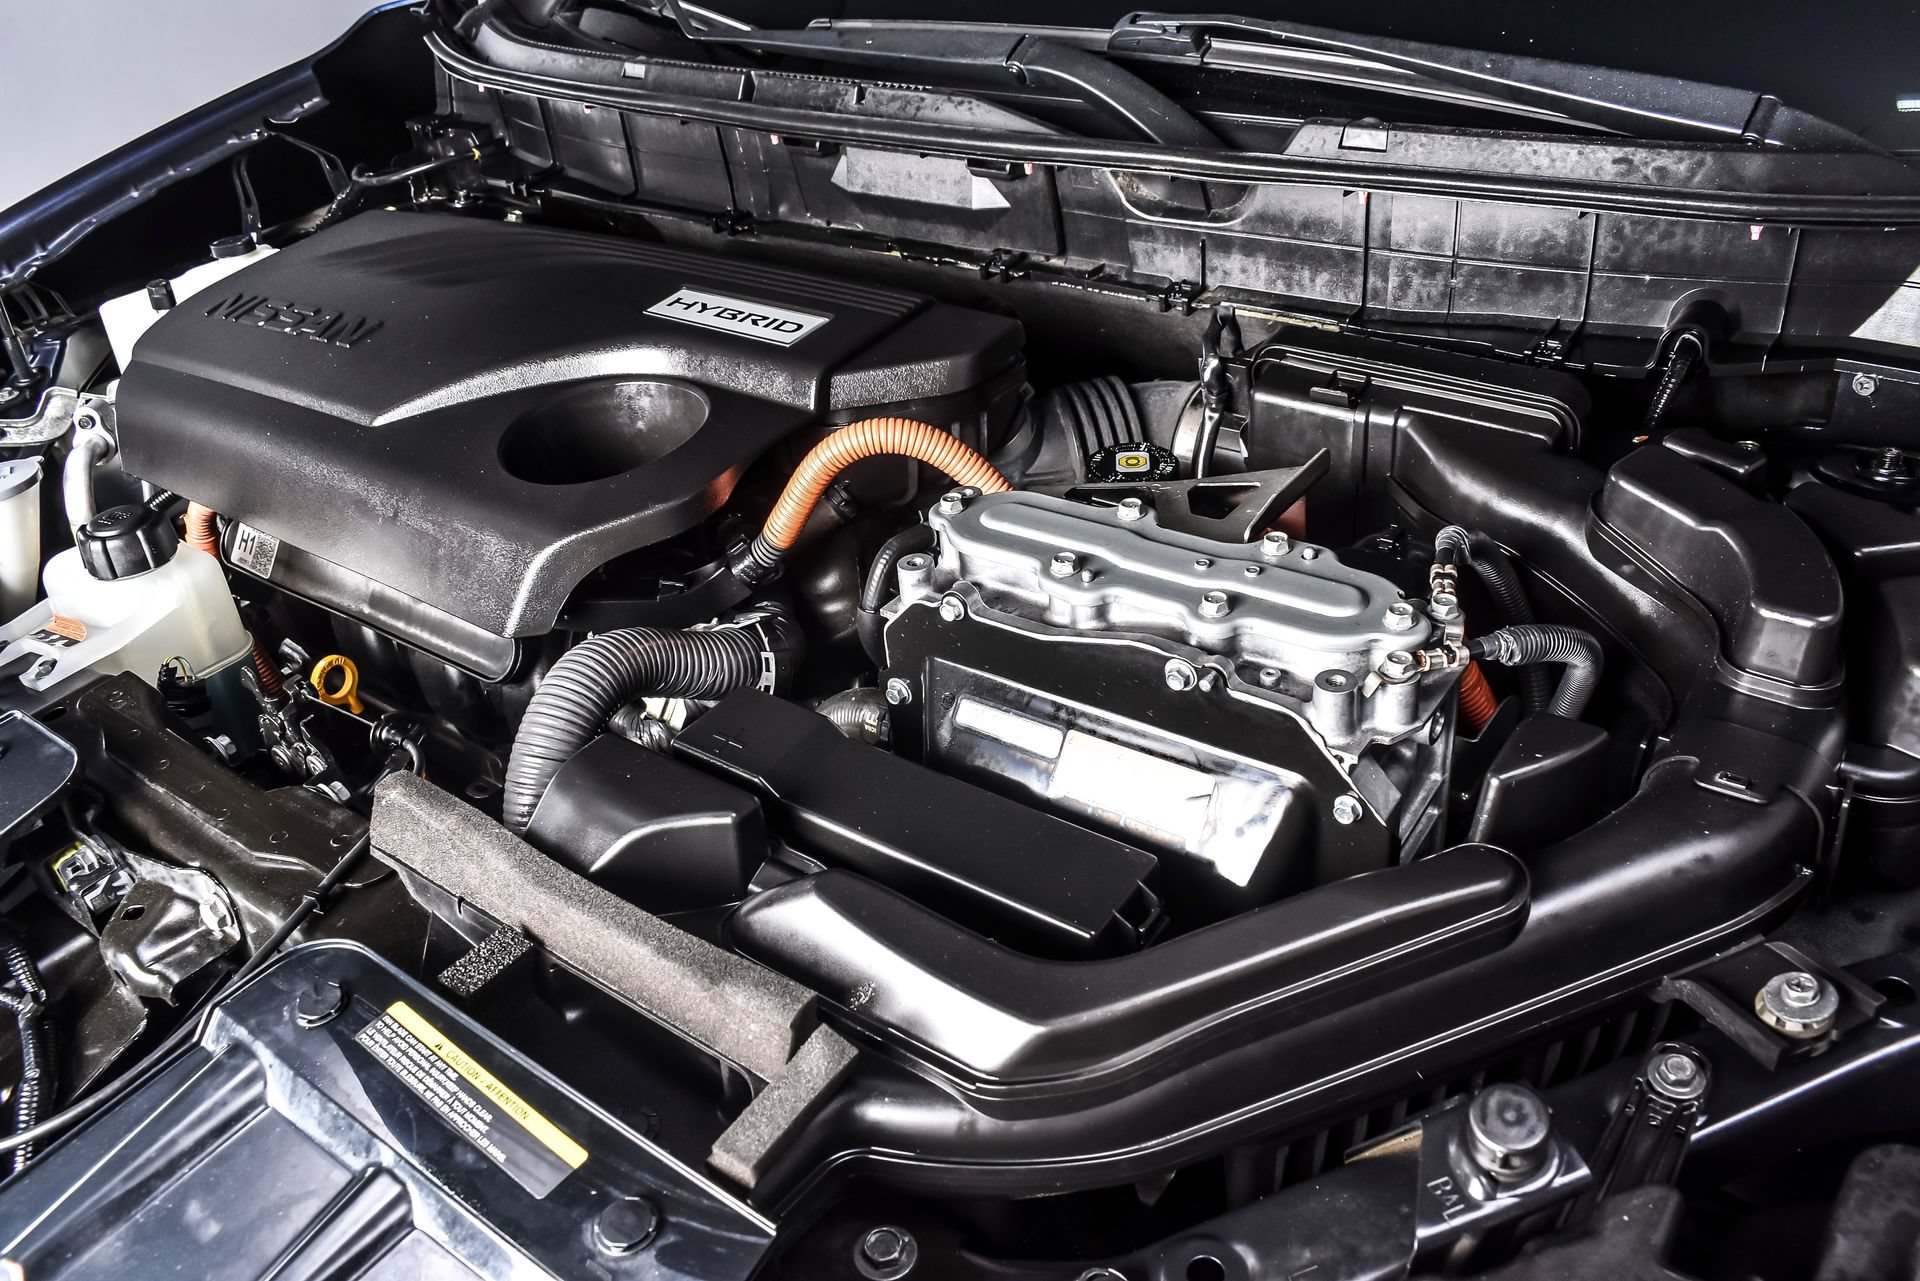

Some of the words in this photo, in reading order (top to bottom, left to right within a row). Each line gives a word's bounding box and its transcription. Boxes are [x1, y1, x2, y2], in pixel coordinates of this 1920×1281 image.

[203, 293, 385, 349] NISSAN
[666, 297, 804, 334] HYBRID
[238, 530, 256, 555] H1
[380, 1025, 396, 1039] HELP
[391, 1035, 409, 1050] AVOID
[404, 1046, 432, 1070] PERSONAL
[455, 1089, 476, 1108] HANDS
[471, 1103, 494, 1123] CLEAR.
[381, 1014, 394, 1025] FAN
[390, 1021, 409, 1037] BLADE
[404, 1033, 418, 1046] CAN
[414, 1042, 432, 1057] START
[433, 1058, 448, 1071] ANY
[443, 1067, 459, 1081] TIME.
[445, 1048, 481, 1080] CAUTION
[485, 1081, 530, 1121] ATTENTION
